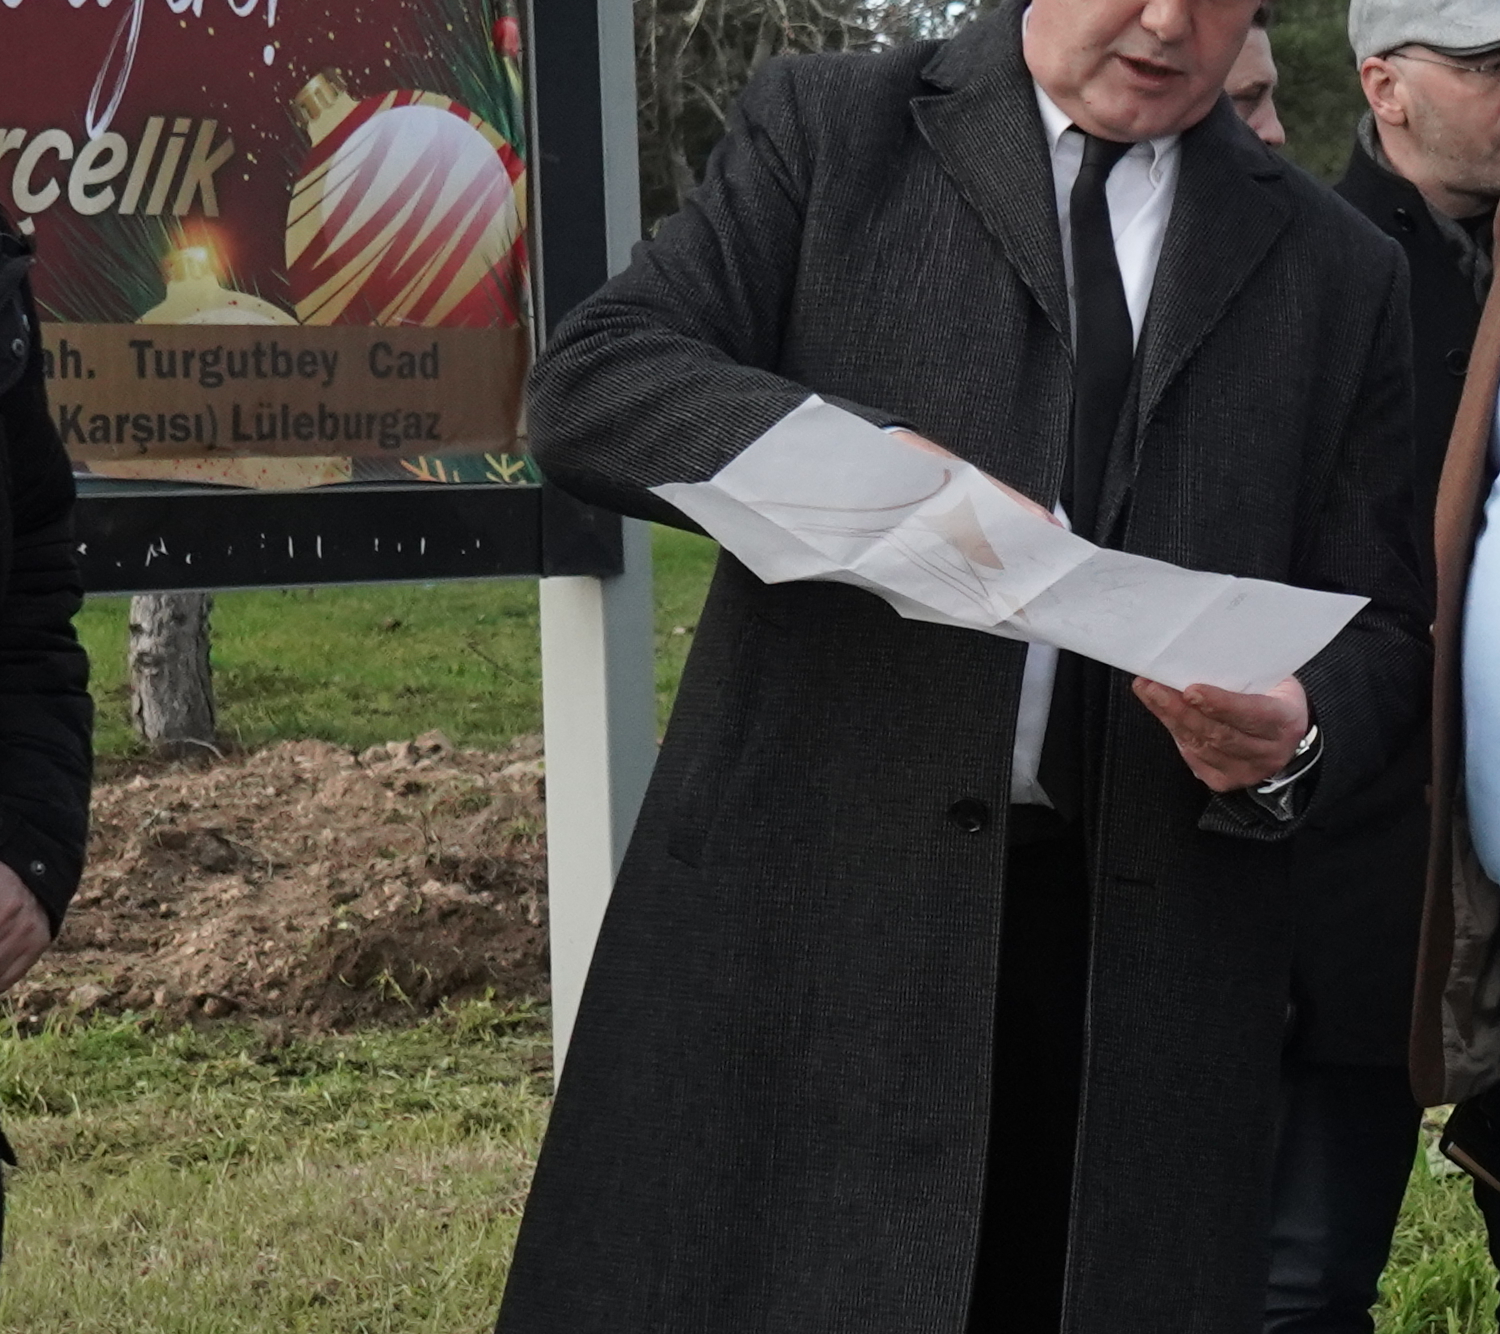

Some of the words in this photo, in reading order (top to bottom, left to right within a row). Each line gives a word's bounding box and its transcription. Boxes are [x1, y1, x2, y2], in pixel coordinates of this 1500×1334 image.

[129, 339, 338, 389] Turgutbey
[368, 341, 440, 380] Cad
[231, 401, 443, 450] Lüleburgaz
